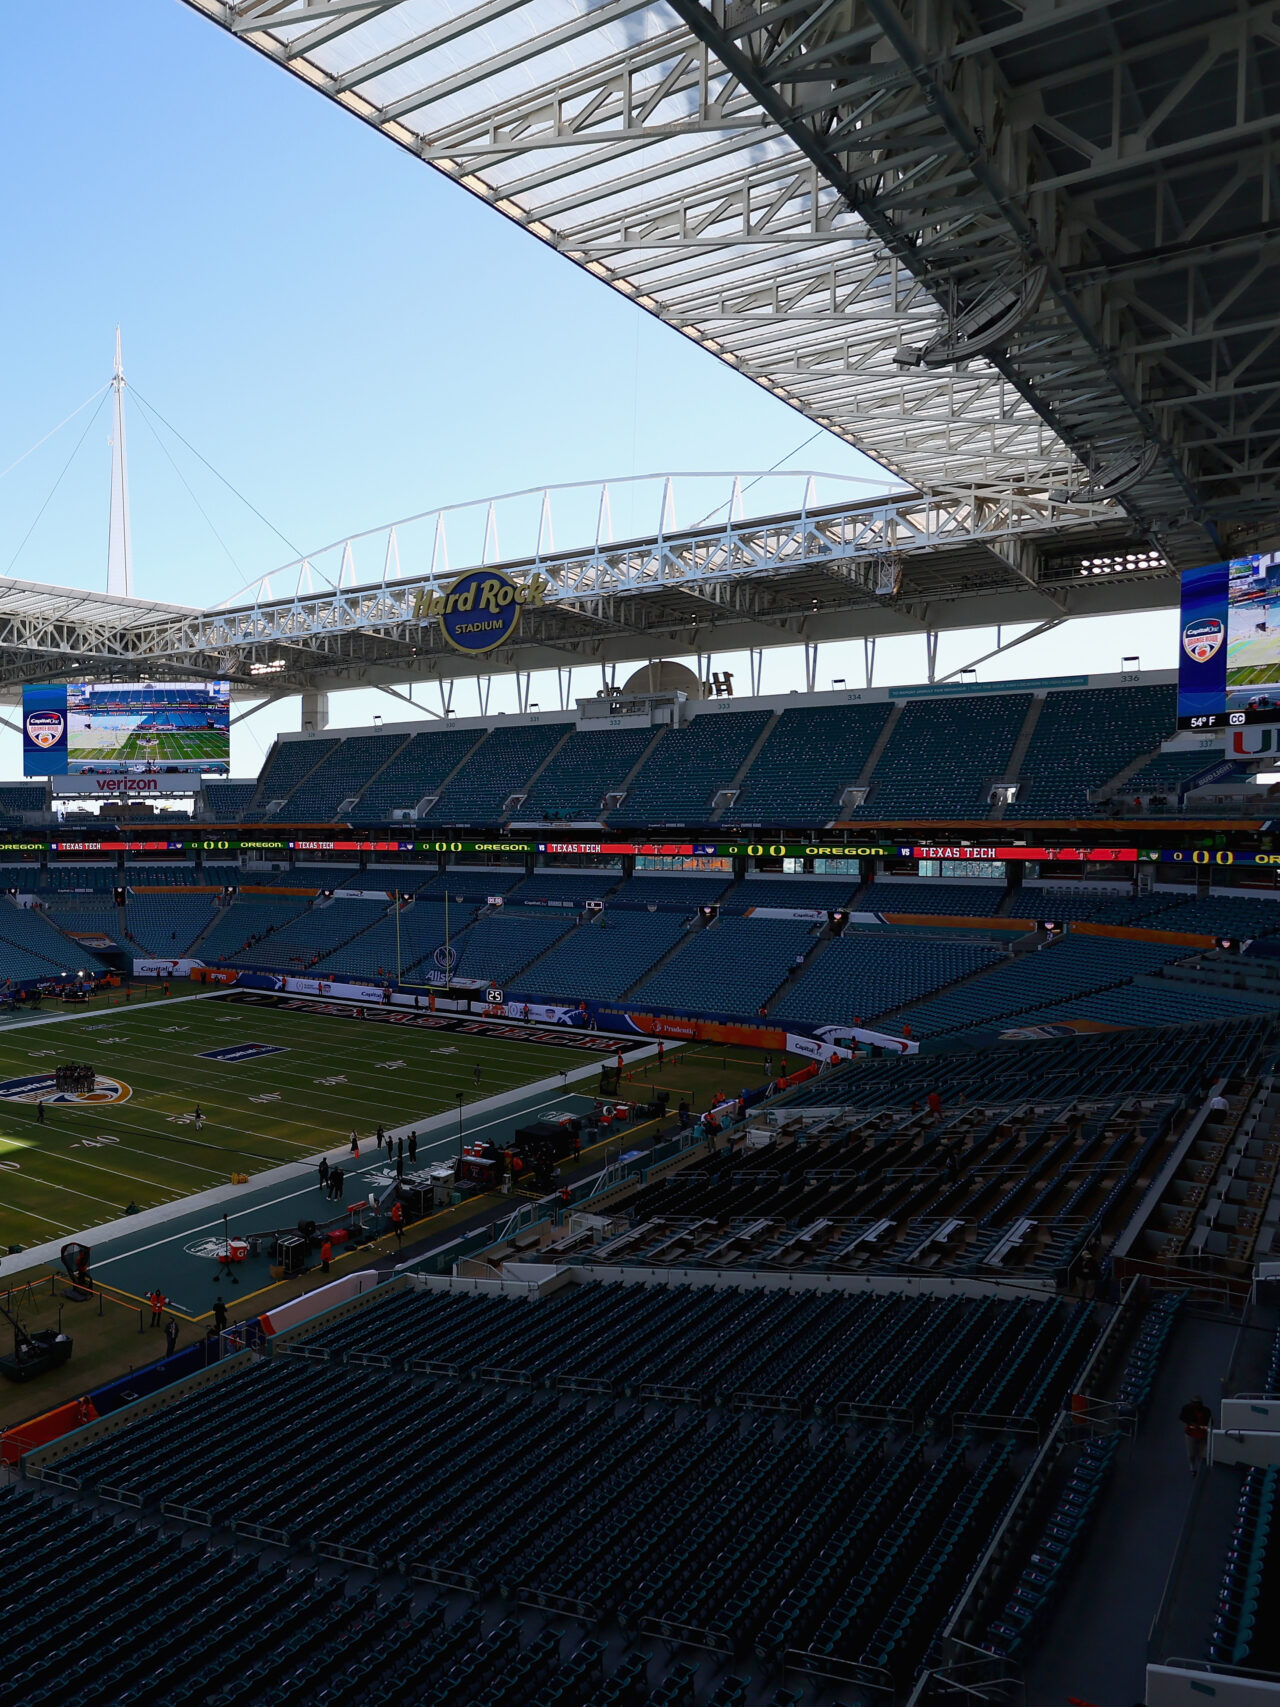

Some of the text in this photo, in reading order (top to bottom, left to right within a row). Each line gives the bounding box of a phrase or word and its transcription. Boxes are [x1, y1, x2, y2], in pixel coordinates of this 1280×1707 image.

[412, 572, 549, 618] Hard Rock
[455, 619, 504, 635] STADIUM
[848, 693, 862, 701] 334
[1209, 716, 1216, 725] F
[1230, 714, 1244, 723] CC
[96, 776, 158, 791] verizon
[552, 844, 578, 852] TEXAS
[580, 844, 601, 852] TECH
[805, 847, 883, 855] OREGON
[920, 848, 960, 858] TEXAS
[964, 848, 996, 858] TECH
[488, 990, 501, 1001] 25
[456, 1021, 634, 1051] TECH
[81, 1134, 121, 1148] 40
[236, 1249, 245, 1257] G
